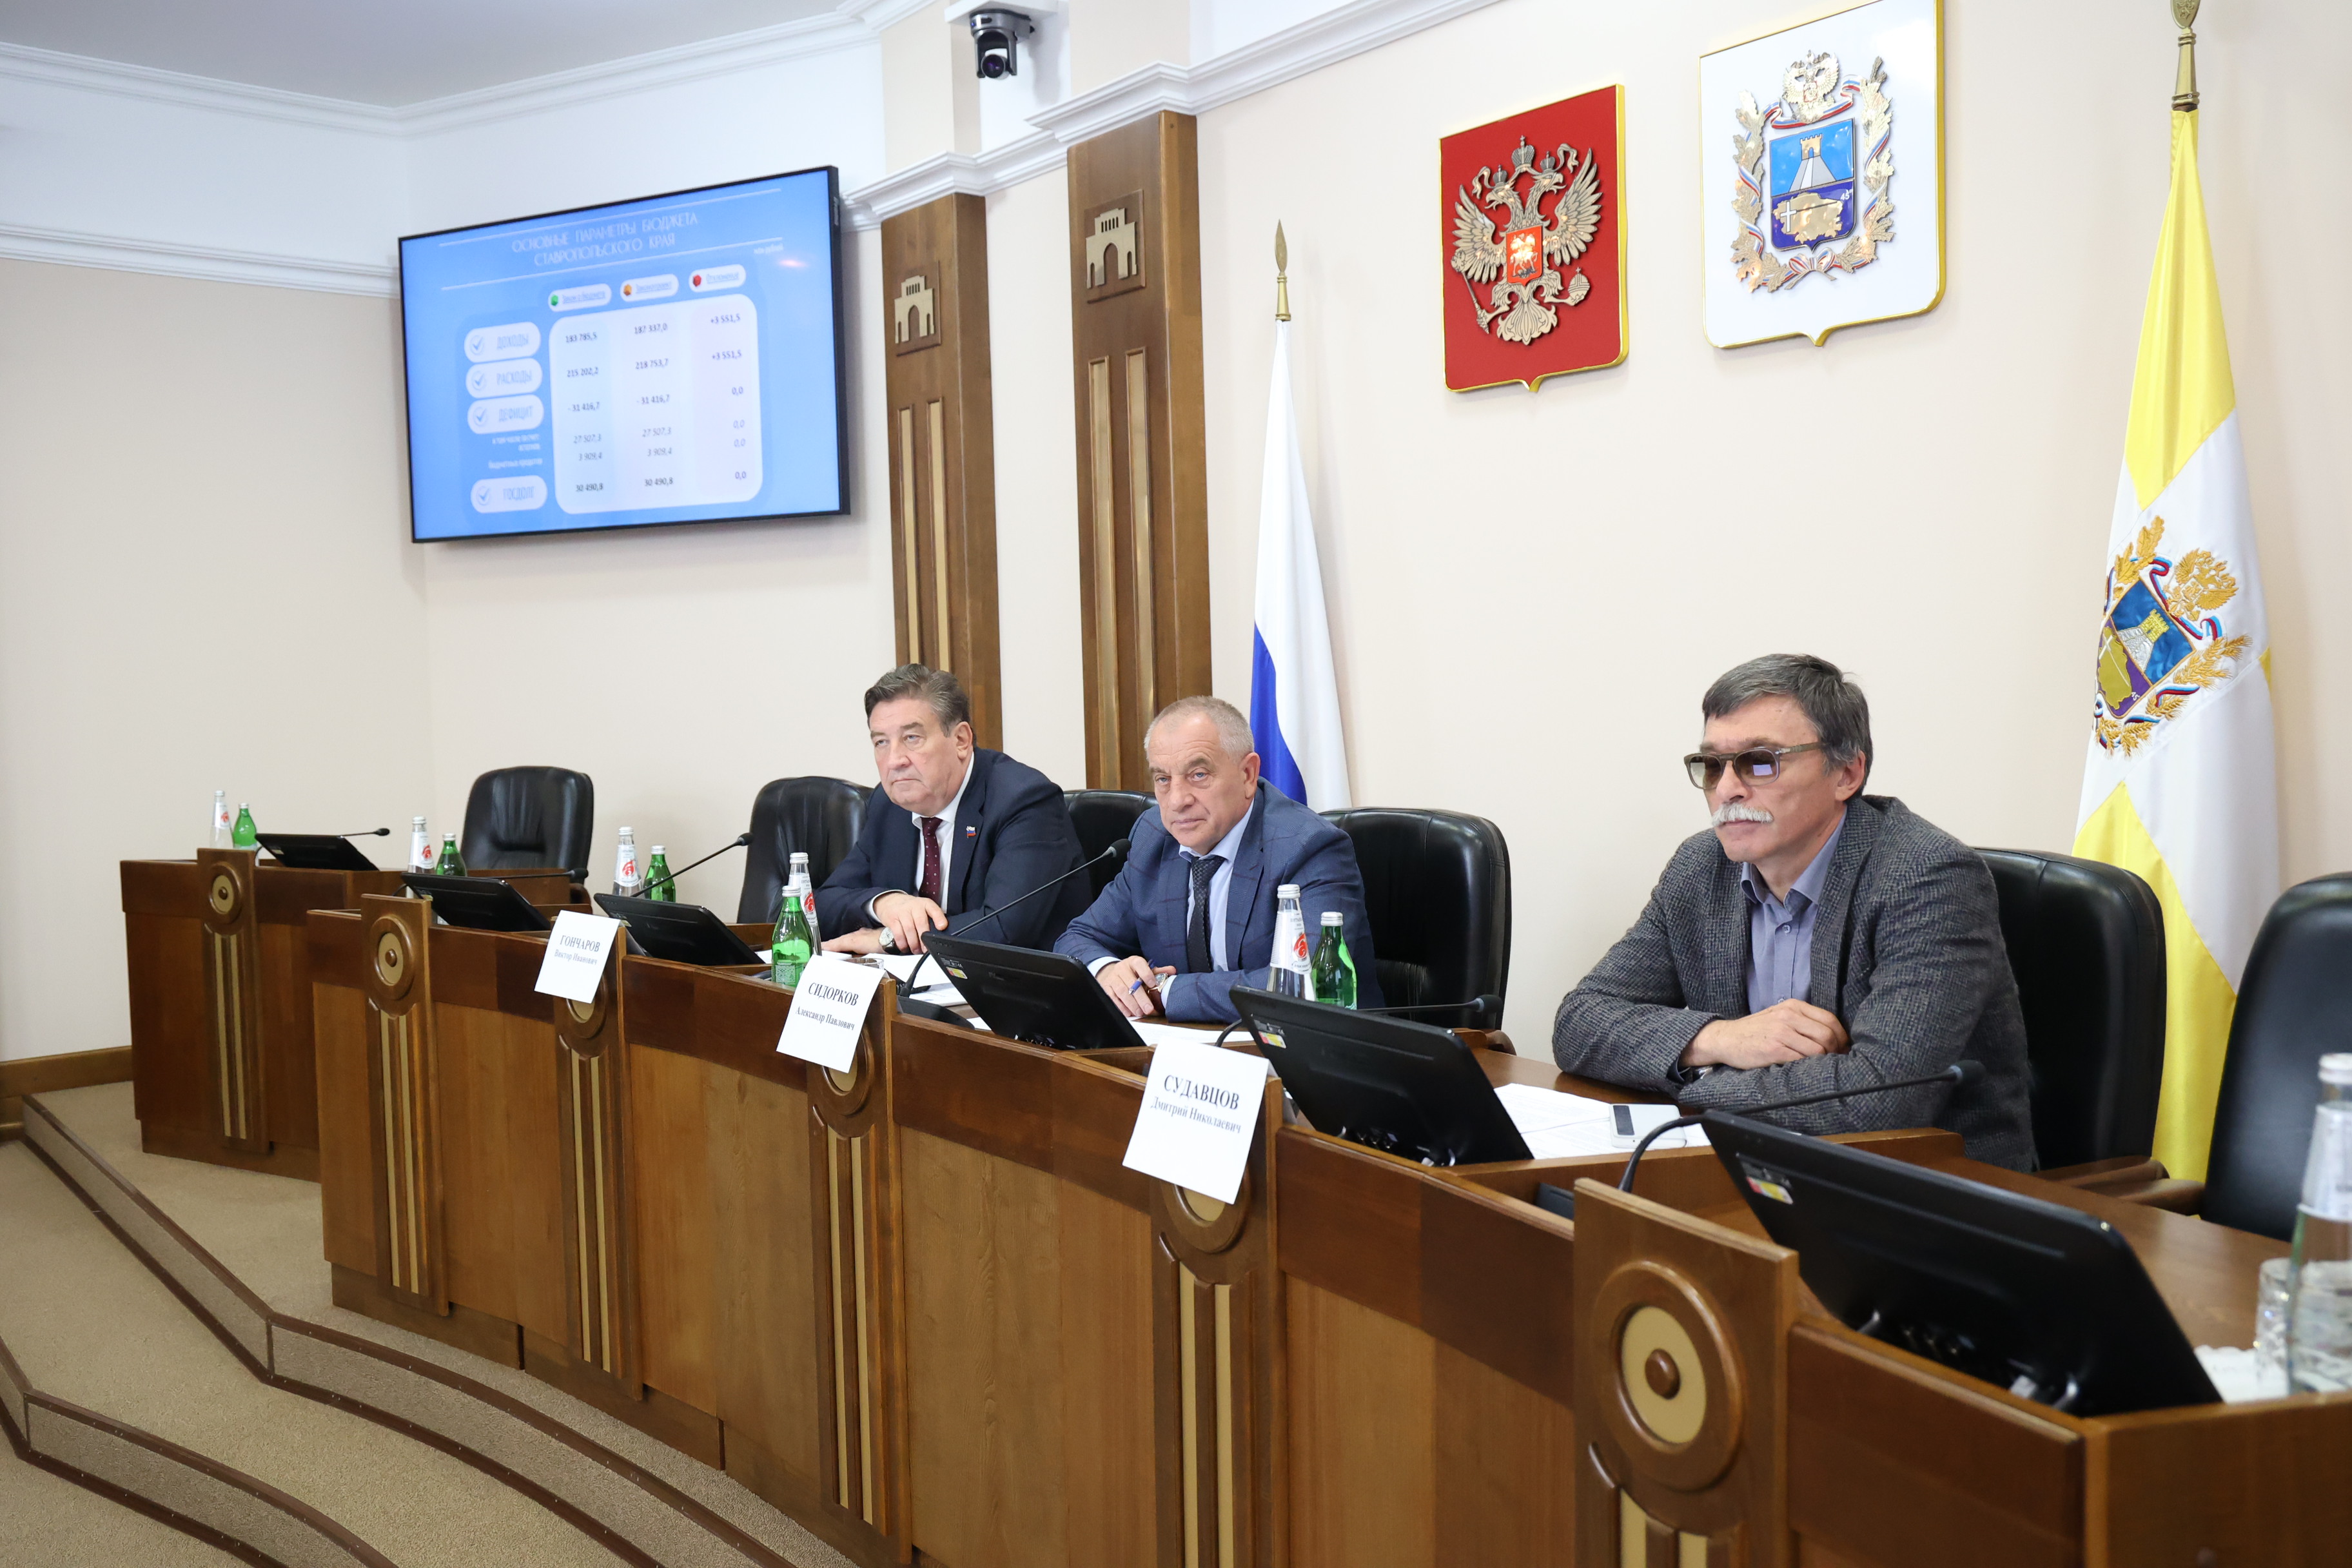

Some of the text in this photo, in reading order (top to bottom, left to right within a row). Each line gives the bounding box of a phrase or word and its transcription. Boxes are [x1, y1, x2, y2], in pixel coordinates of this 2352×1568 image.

[511, 212, 698, 253] ОСНОВНЫЕ ПАРАМЕТРЫ БЮДЖЕТА
[534, 233, 675, 266] СТАВРОПОЛЬСКОГО КРАЯ
[731, 386, 744, 396] 0,0
[560, 935, 600, 952] ГОНЧАРОВ
[554, 949, 598, 965] Виктор Иванович
[808, 982, 859, 1006] СИДОРКОВ
[795, 1006, 855, 1031] Александр Павлович
[1164, 1074, 1239, 1110] СУДАВЦОВ
[1150, 1096, 1242, 1133] Дмитрий Николаевич
